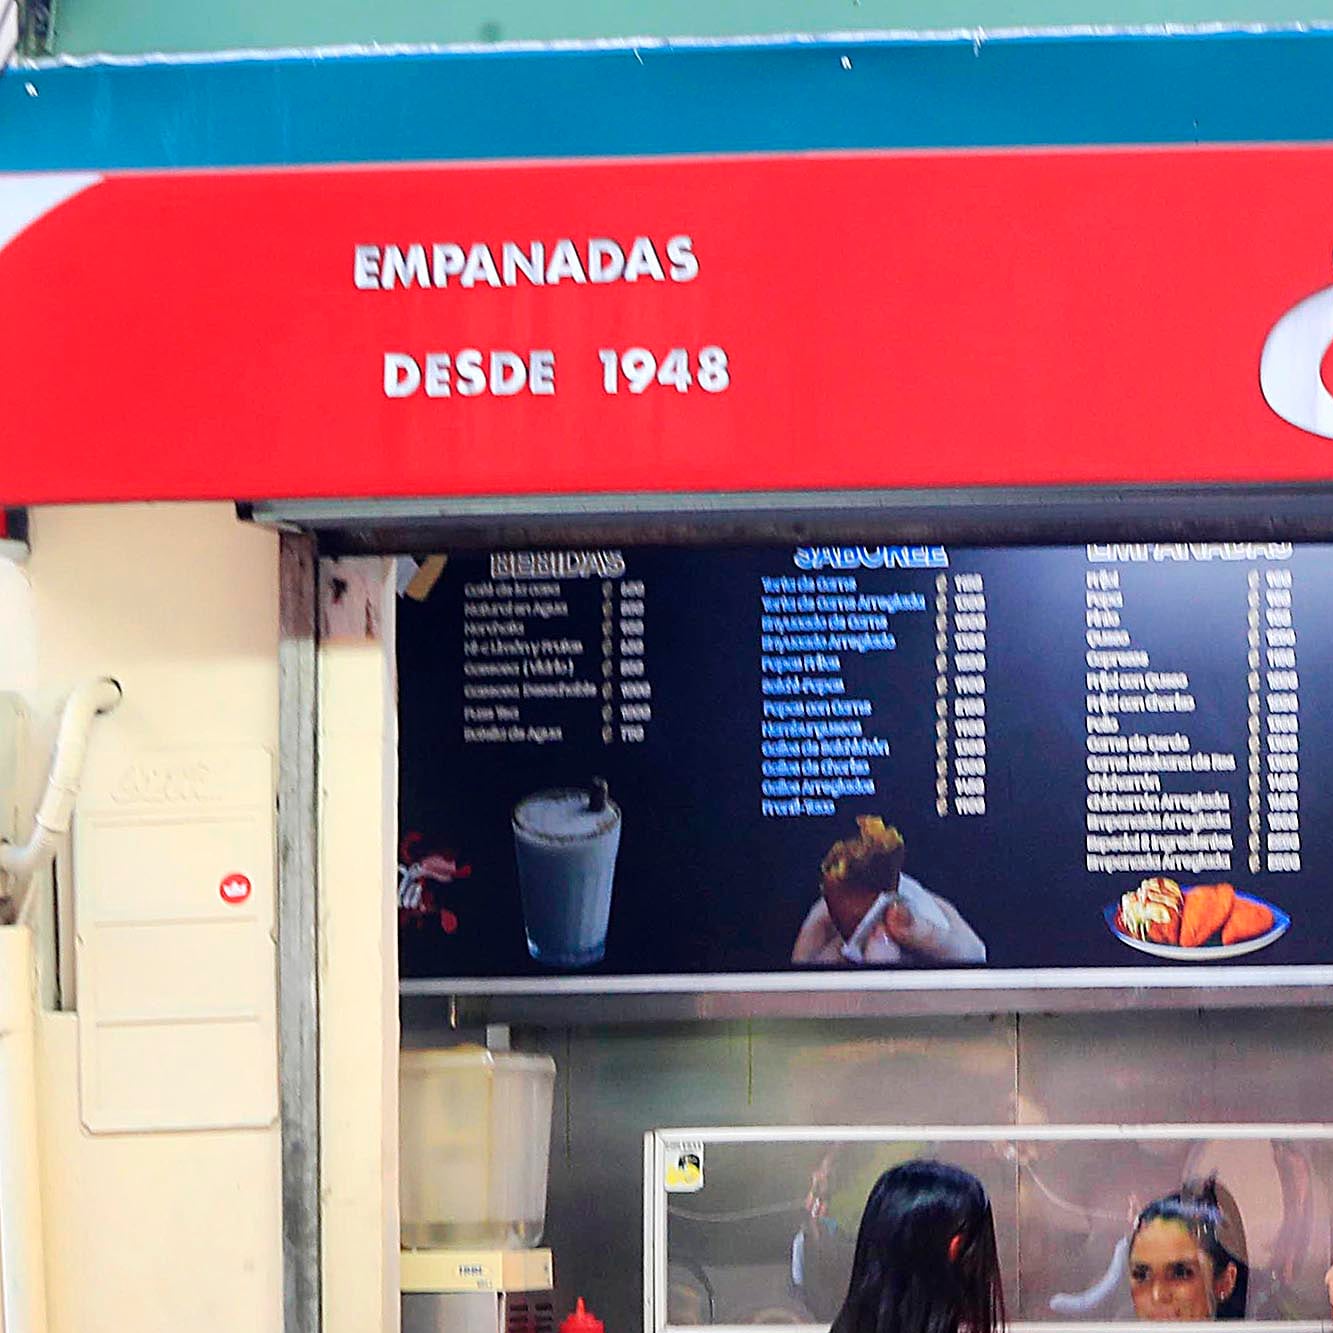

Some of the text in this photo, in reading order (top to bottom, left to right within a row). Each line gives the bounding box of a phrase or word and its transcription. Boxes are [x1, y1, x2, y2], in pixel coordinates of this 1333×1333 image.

[353, 236, 700, 290] EMPANADAS
[383, 345, 730, 398] DESDE 1948
[490, 549, 626, 580] BEBIDAS
